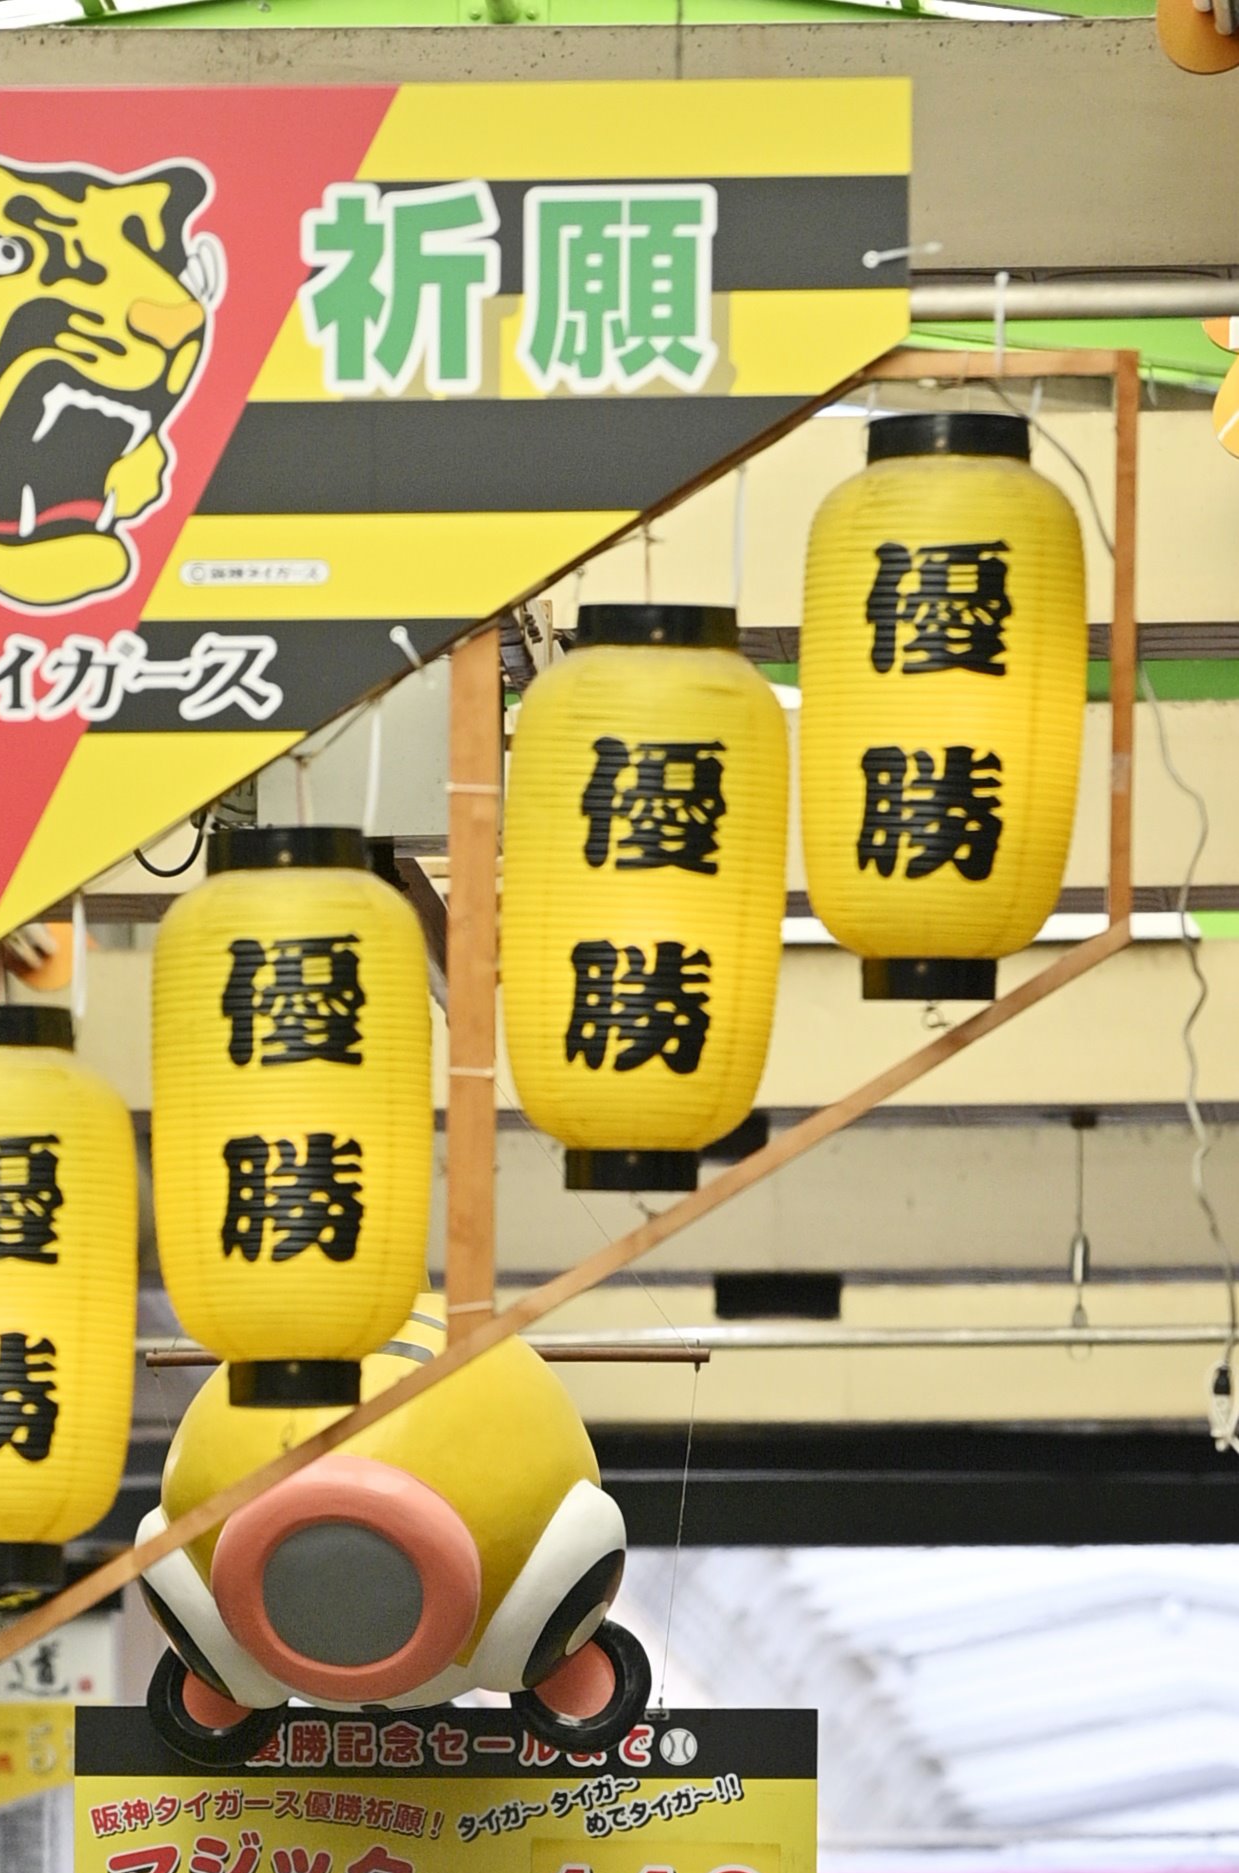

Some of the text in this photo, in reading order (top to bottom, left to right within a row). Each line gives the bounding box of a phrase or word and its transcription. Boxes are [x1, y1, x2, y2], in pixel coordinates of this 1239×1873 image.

[303, 181, 717, 394] 祈願
[856, 540, 1012, 881] 優勝
[564, 736, 727, 1074] 優勝
[221, 934, 366, 1263] 優勝
[89, 1788, 444, 1838] 阪神タイガース優勝祈願!
